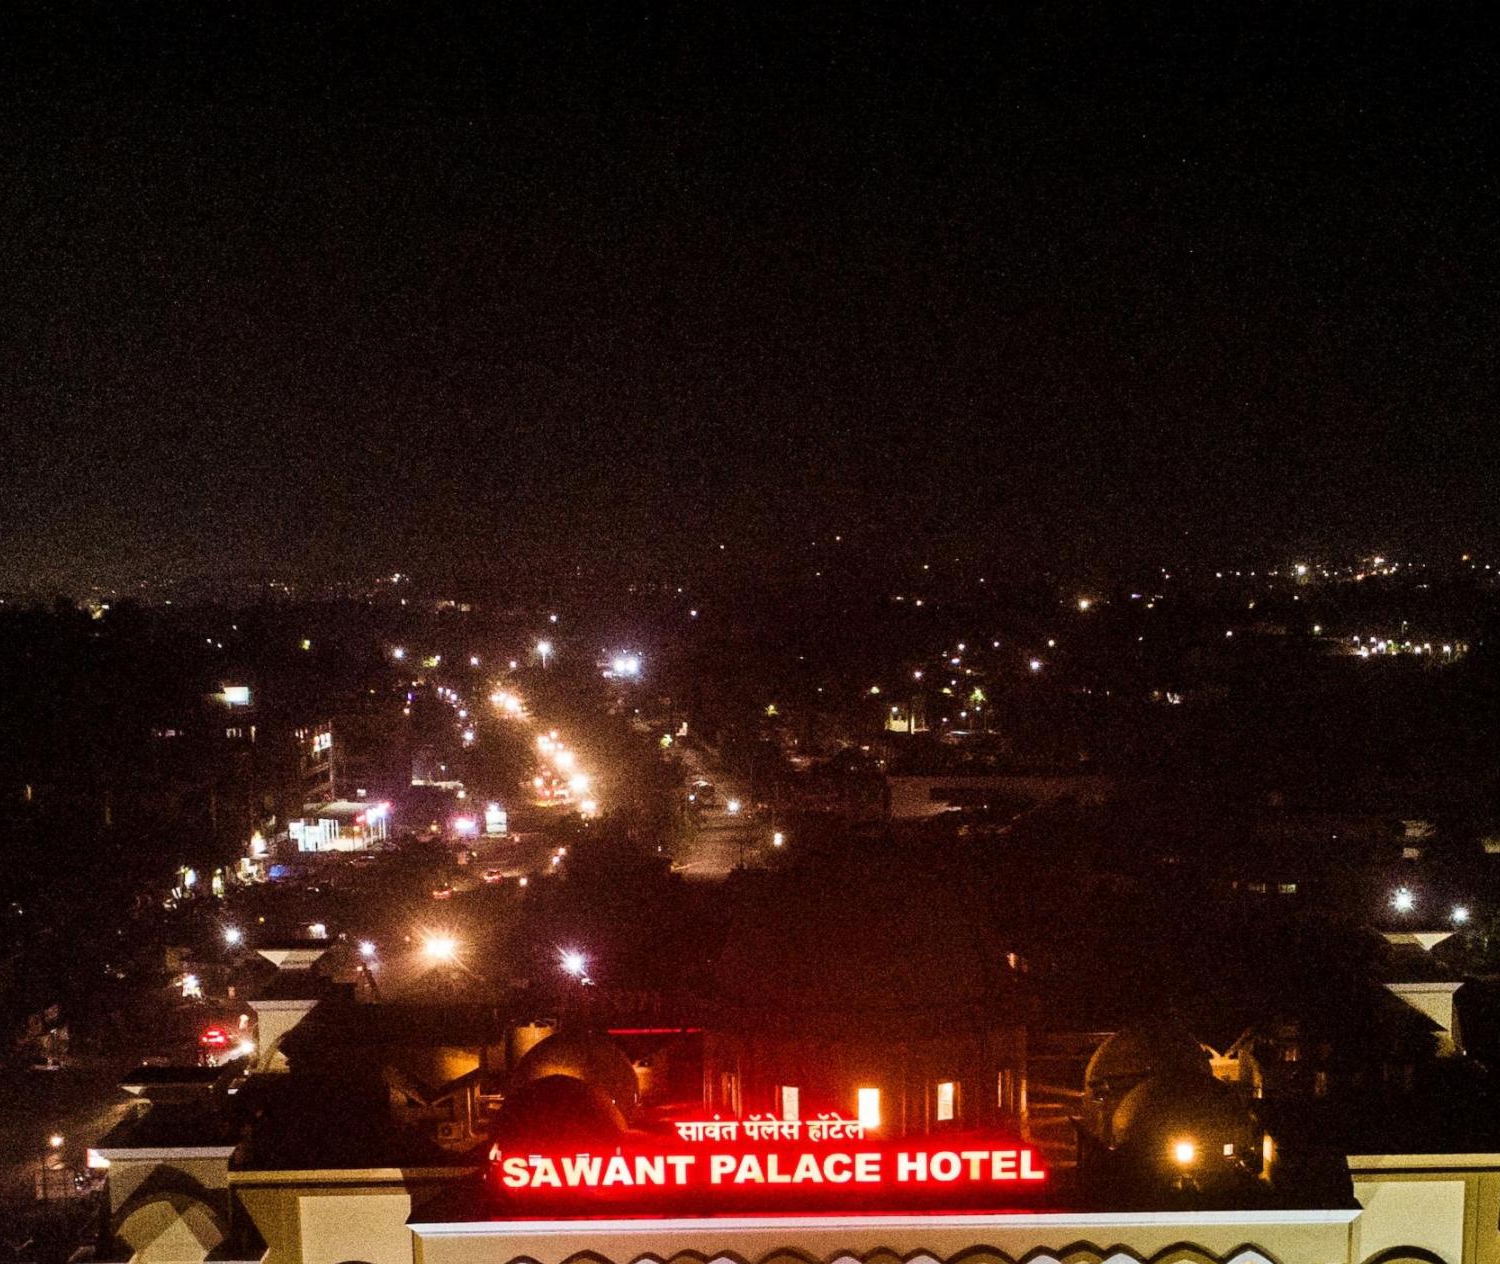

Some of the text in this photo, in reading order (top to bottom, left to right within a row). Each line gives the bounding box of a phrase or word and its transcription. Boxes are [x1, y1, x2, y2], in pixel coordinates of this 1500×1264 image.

[675, 1112, 865, 1142] सावंत पॅलेस हॉटेल
[503, 1150, 1045, 1187] SAWANT PALACE HOTEL
